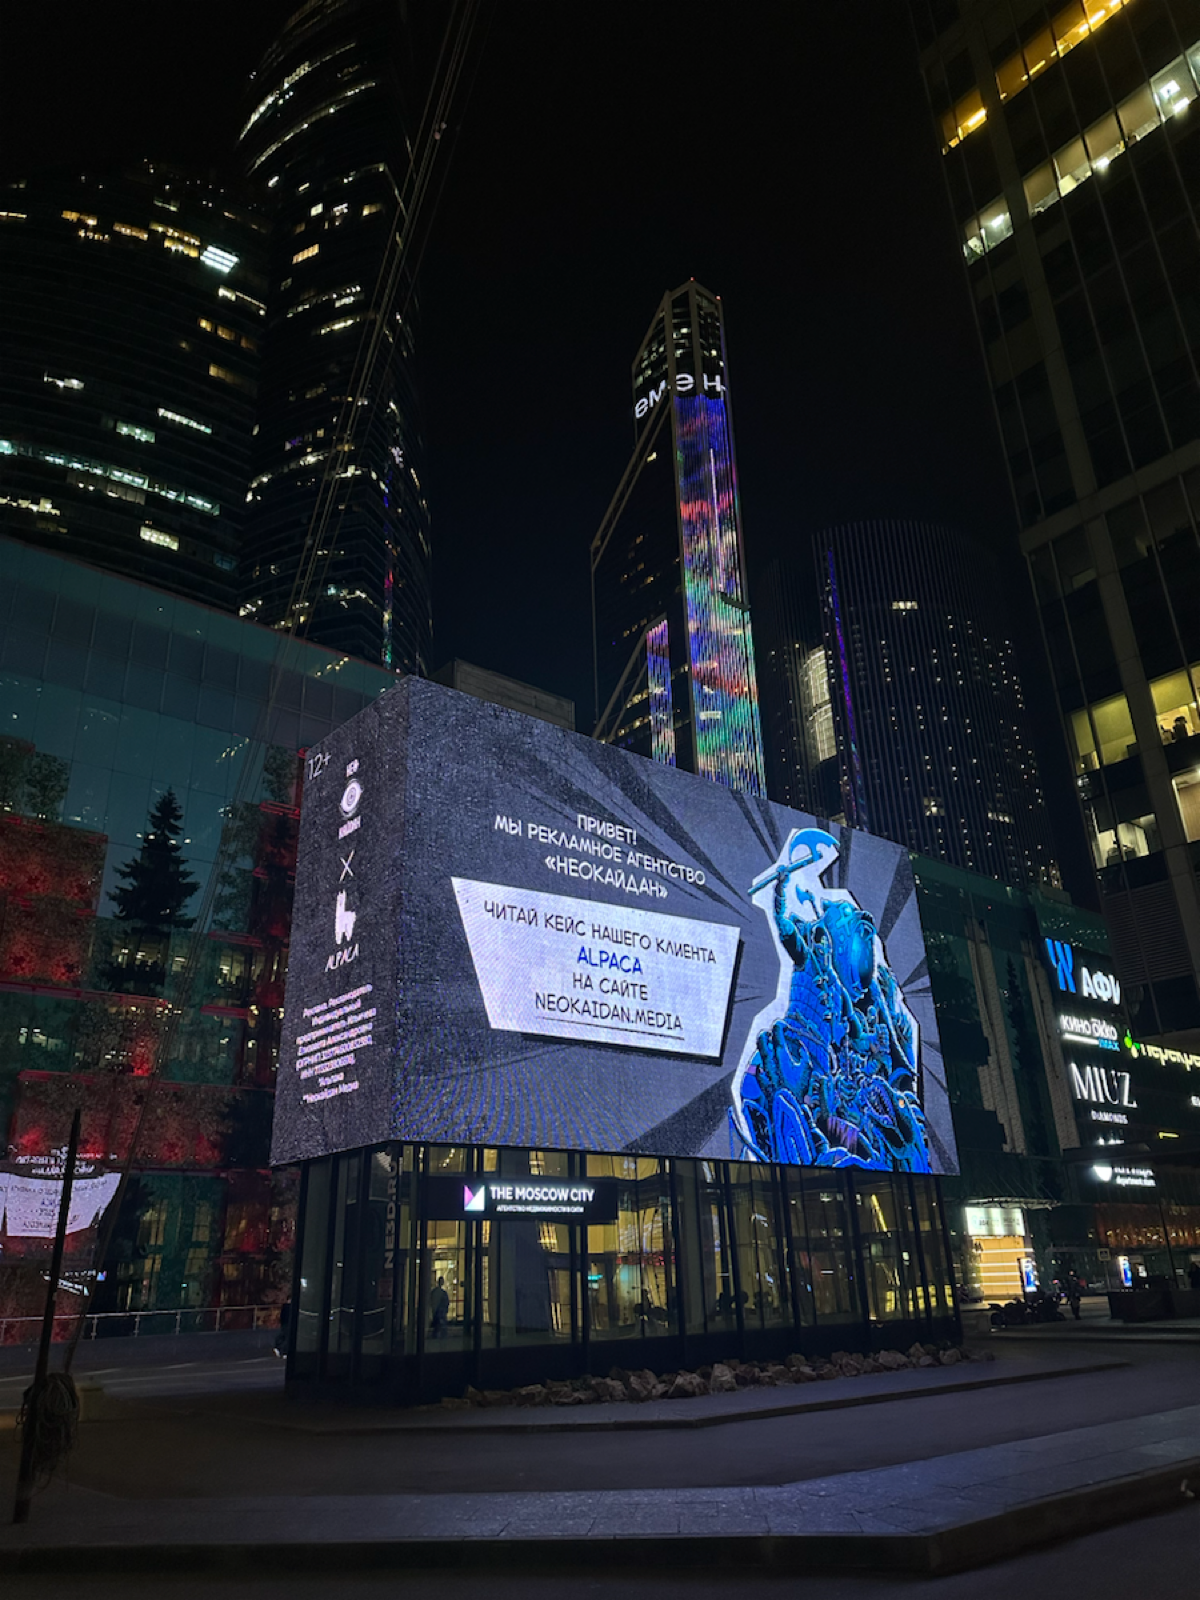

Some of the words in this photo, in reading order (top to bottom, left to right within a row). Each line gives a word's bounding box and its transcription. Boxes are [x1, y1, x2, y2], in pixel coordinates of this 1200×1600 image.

[308, 752, 331, 780] 12+
[577, 814, 637, 845] ПРИВЕТ!
[494, 815, 522, 836] МЫ
[528, 823, 622, 863] РЕКЛАМНОЕ
[627, 851, 705, 885] АГЕНТСТВО
[544, 855, 668, 898] «НЕОКАЙДАН»
[484, 900, 538, 927] ЧИТАЙ
[544, 912, 586, 937] КЕЙС
[592, 923, 651, 949] НАШЕГО
[656, 938, 716, 964] КЛИЕНТА
[577, 946, 643, 975] ALPACA
[573, 972, 593, 990] НА
[600, 976, 648, 1001] САЙТЕ
[535, 992, 683, 1030] NEOKAIDAN.MEDIA
[1061, 1015, 1091, 1035] КИНО
[1070, 1062, 1138, 1108] MIUZ
[491, 1187, 513, 1200] THE
[515, 1187, 569, 1201] MOSCOW
[570, 1189, 595, 1202] CITY
